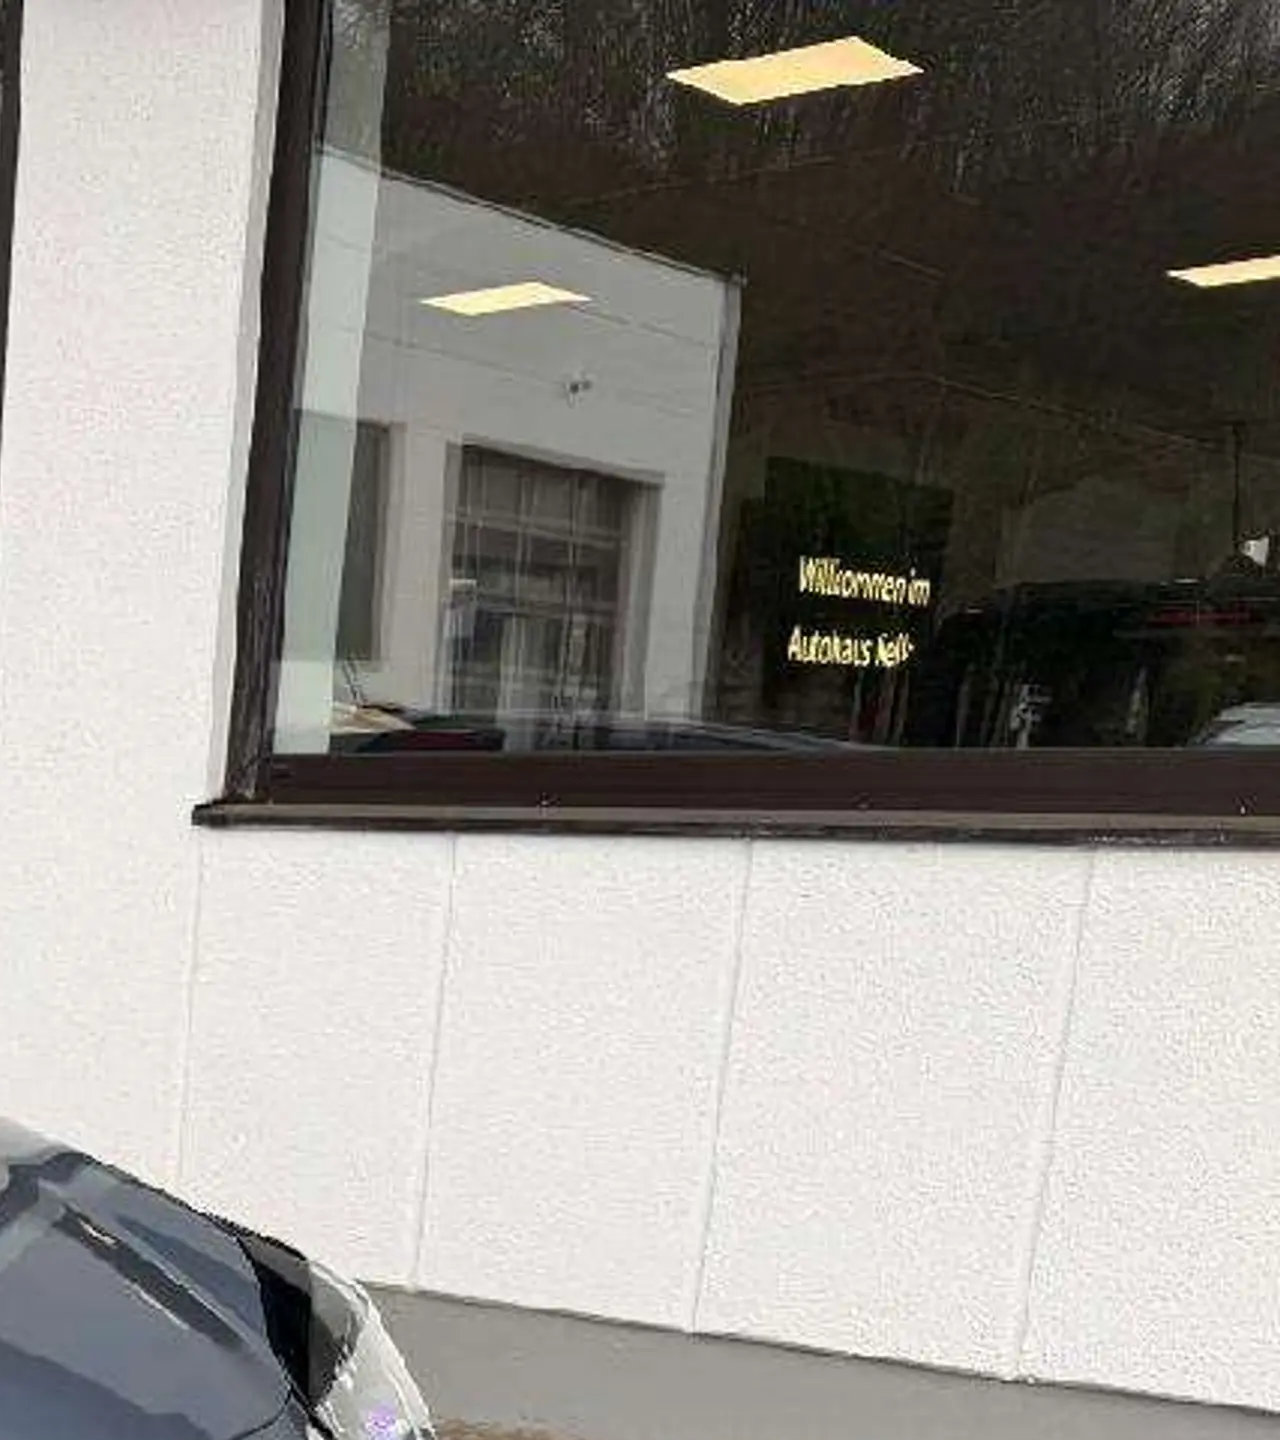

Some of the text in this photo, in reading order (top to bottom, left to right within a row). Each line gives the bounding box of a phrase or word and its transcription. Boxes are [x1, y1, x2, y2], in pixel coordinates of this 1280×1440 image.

[799, 555, 931, 607] Willkommen im
[788, 624, 872, 667] Autohaus
